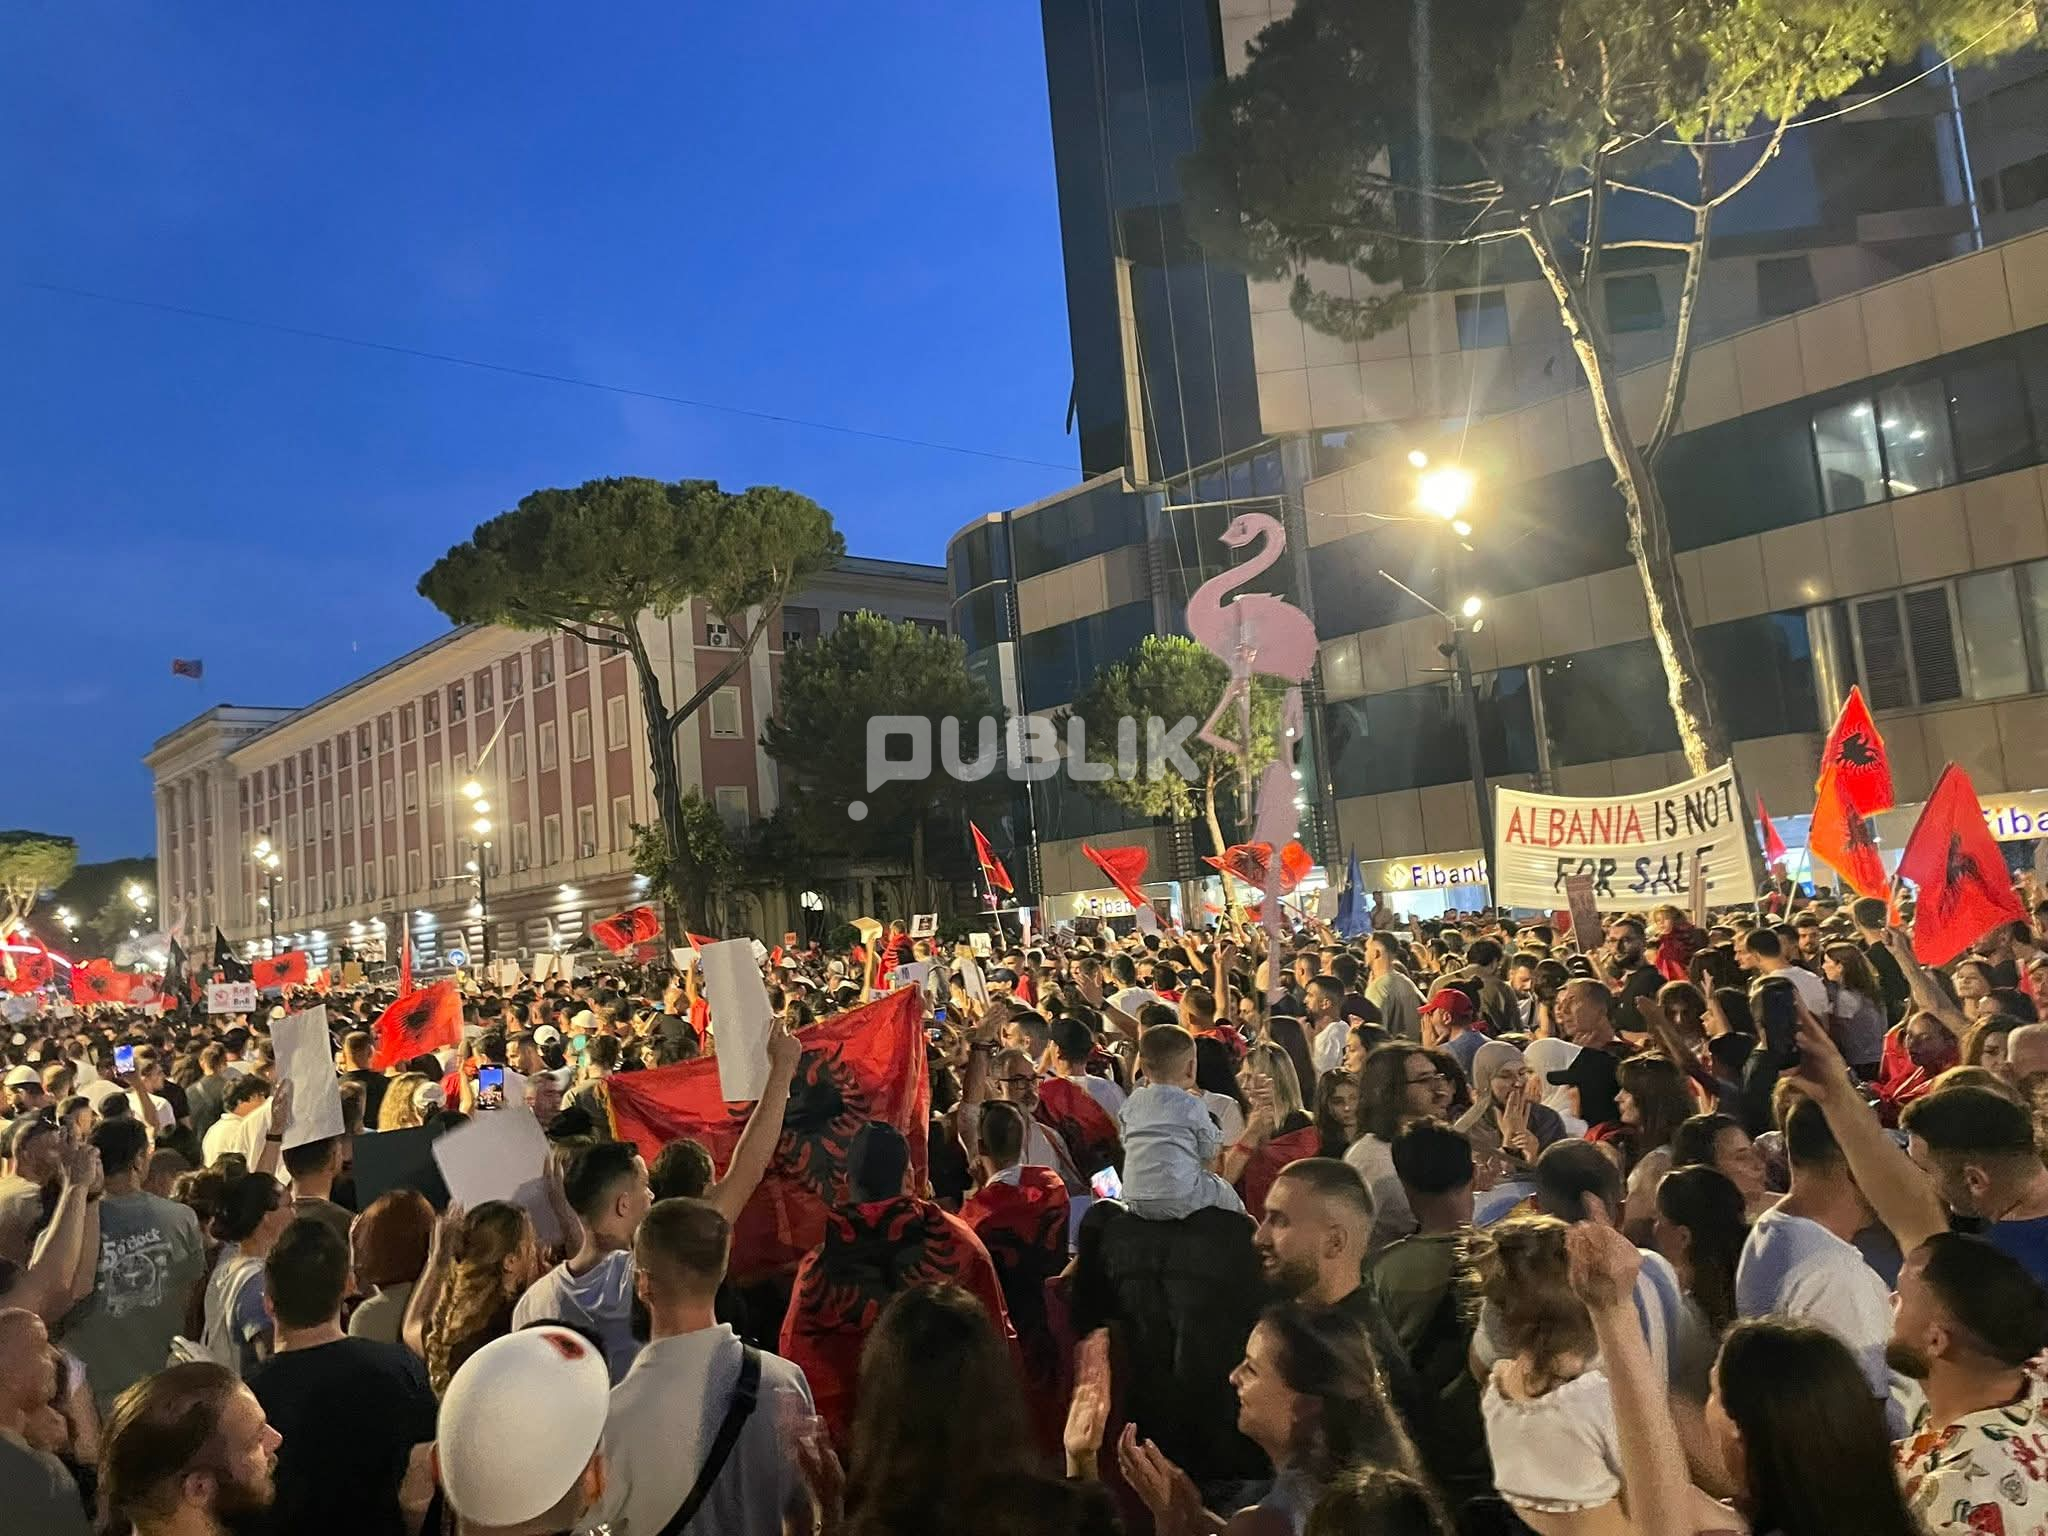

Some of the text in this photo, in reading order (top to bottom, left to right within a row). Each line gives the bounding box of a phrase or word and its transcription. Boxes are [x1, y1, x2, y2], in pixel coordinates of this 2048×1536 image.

[1505, 778, 1734, 848] ALBANIA IS NOT
[1982, 807, 2048, 836] iba
